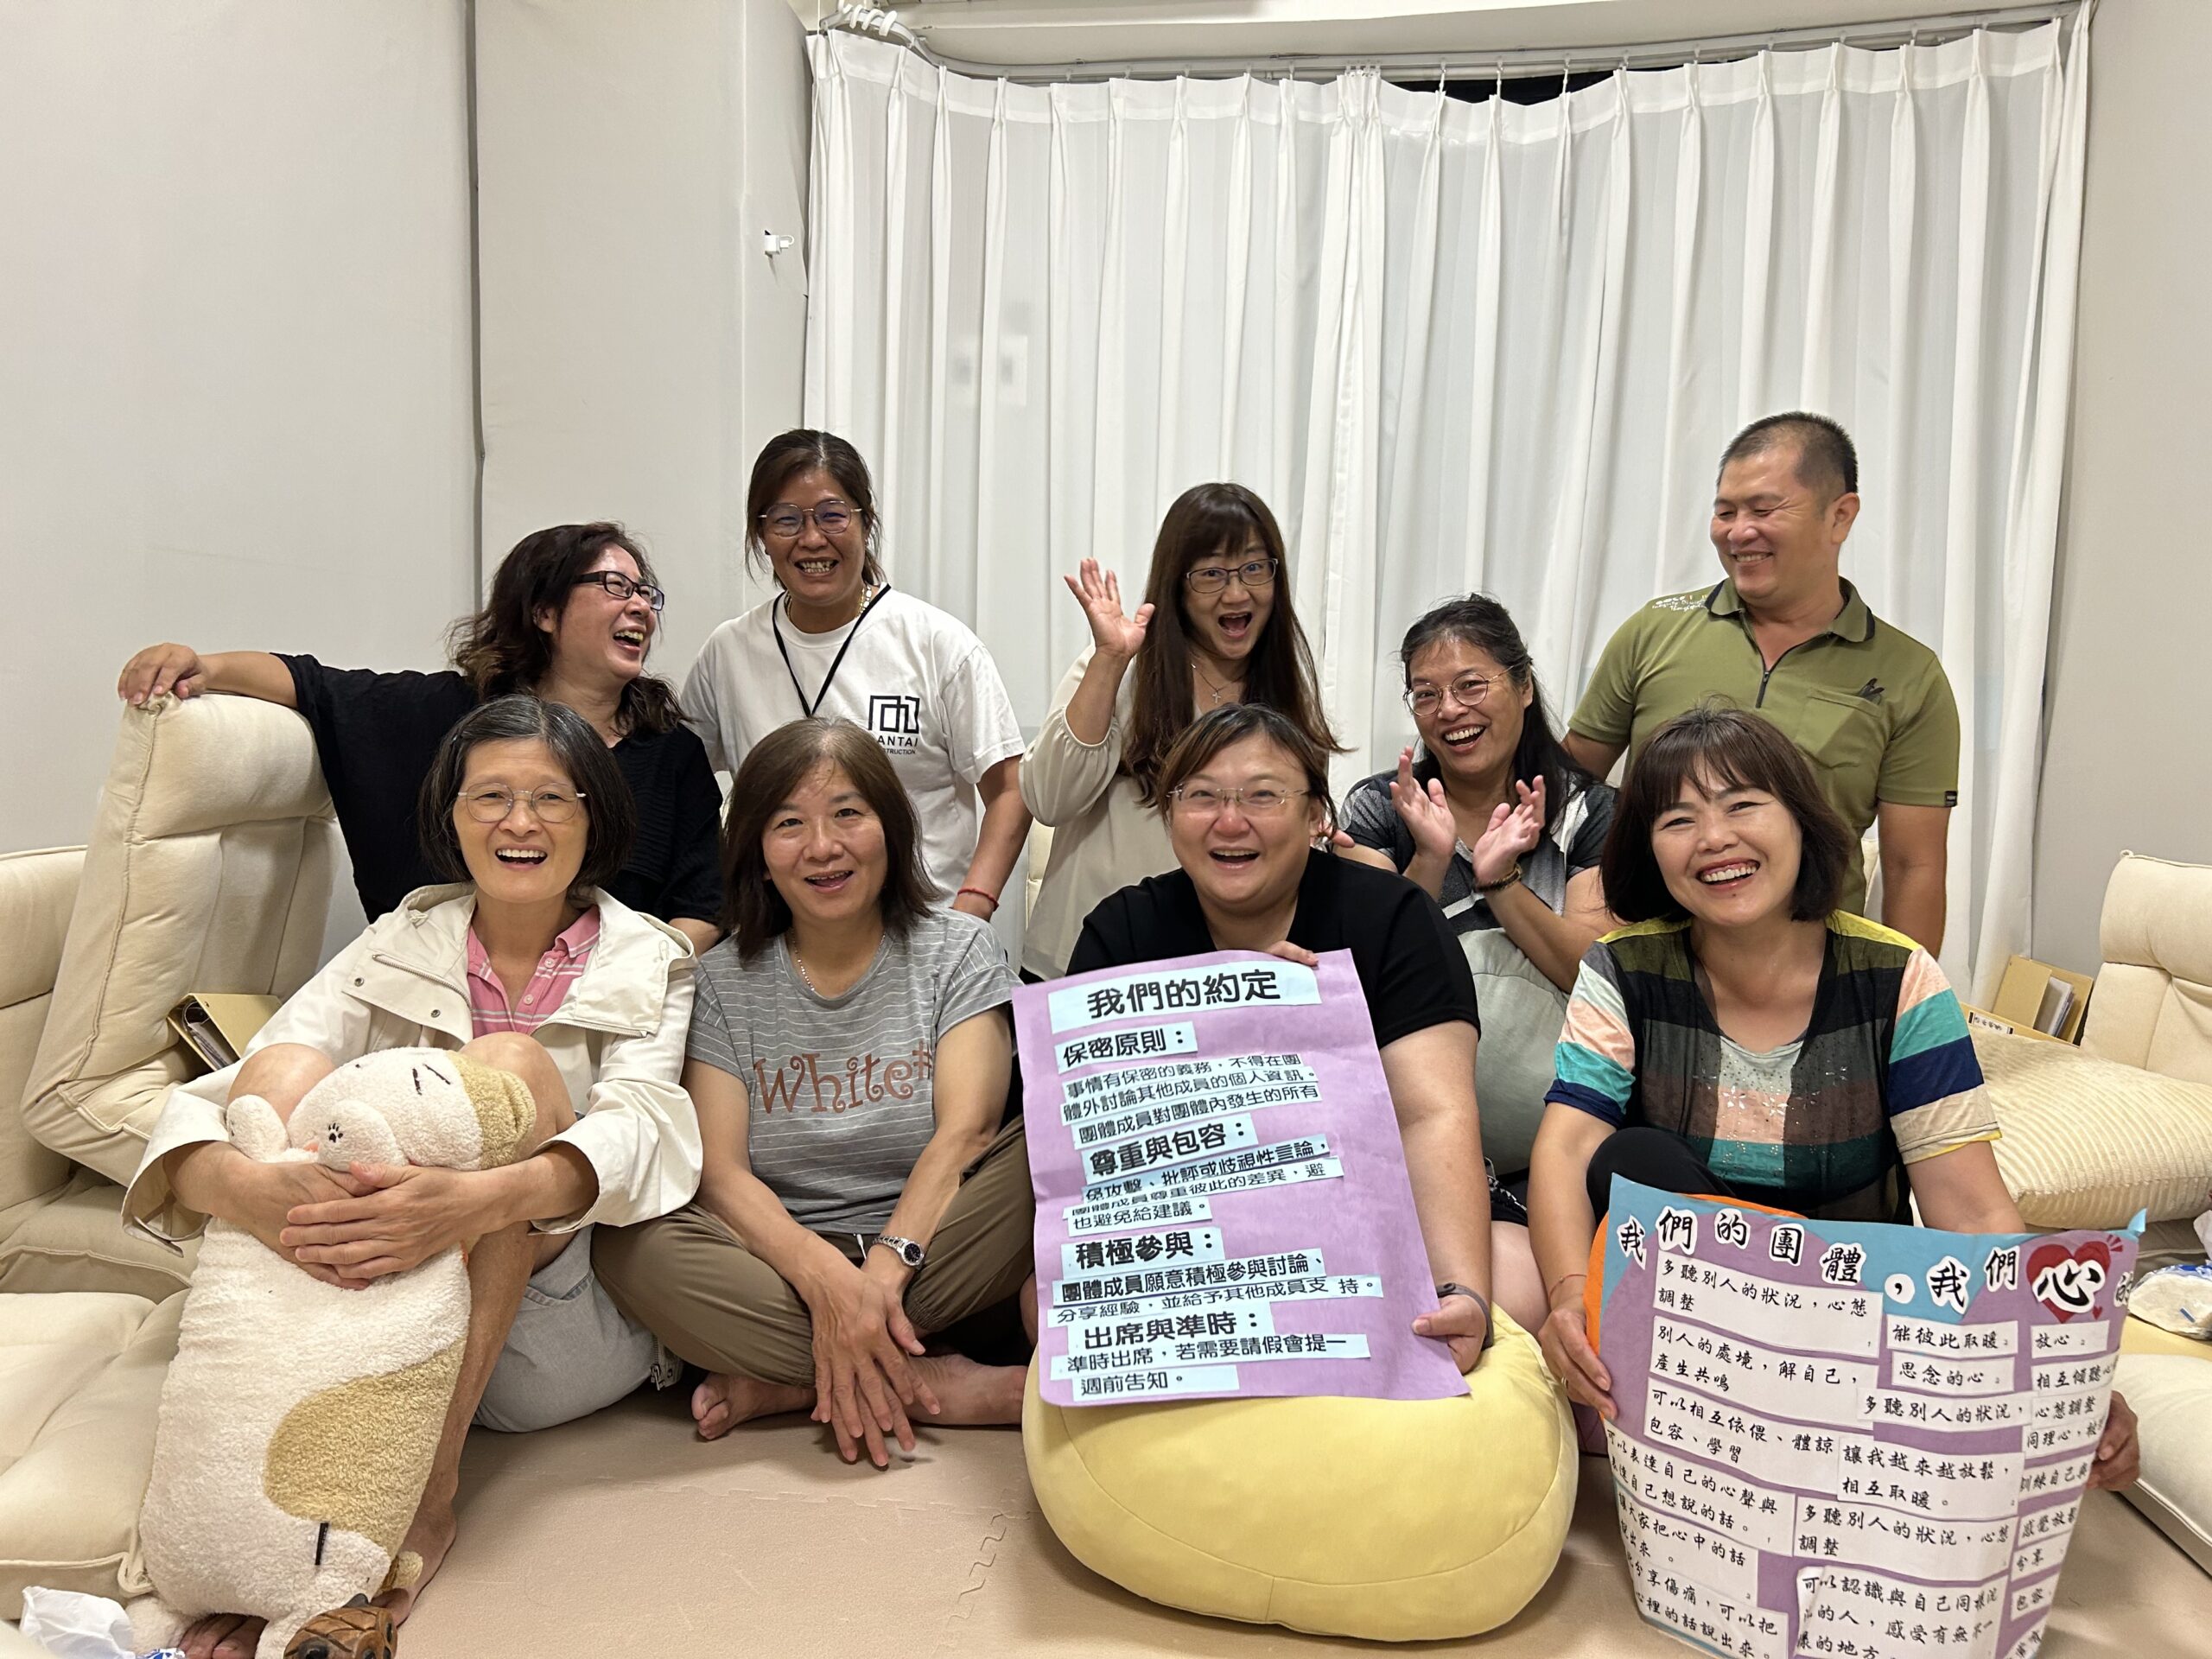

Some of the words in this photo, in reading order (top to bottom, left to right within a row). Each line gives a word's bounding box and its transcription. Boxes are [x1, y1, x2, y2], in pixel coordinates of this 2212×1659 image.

[877, 734, 918, 747] ANTAI
[1087, 969, 1281, 1019] 我們的約定
[1063, 1027, 1184, 1067] 保密原則：
[1078, 1084, 1319, 1144] 團體成員對團體內發生的所有
[1090, 1122, 1245, 1176] 尊重與包容：
[1073, 1200, 1206, 1230] 也避免給建議。
[1076, 1232, 1212, 1270] 積極參與：
[1062, 1255, 1322, 1303] 團體成員願意積極參與討論、
[1662, 1258, 1867, 1317] 多聽別人的狀況，心態
[1658, 1287, 1695, 1313] 調整
[1084, 1312, 1257, 1350] 出席與準時：
[1892, 1324, 1999, 1350] 能彼此取暖
[2035, 1332, 2070, 1350] 放心
[1067, 1334, 1346, 1373] 準時出席，若需要請假會提一
[1654, 1352, 1730, 1392] 產生共鳴
[1657, 1325, 1857, 1384] 別人的處境，解自己，
[1081, 1370, 1183, 1395] 週前告知。
[1899, 1361, 1984, 1387] 思念的心
[1649, 1415, 1742, 1464] 包容、學習
[1842, 1445, 2009, 1481] 讓我越來越放鬆，
[1841, 1477, 1949, 1510] 相互取暖。
[1798, 1535, 1840, 1556] 調整
